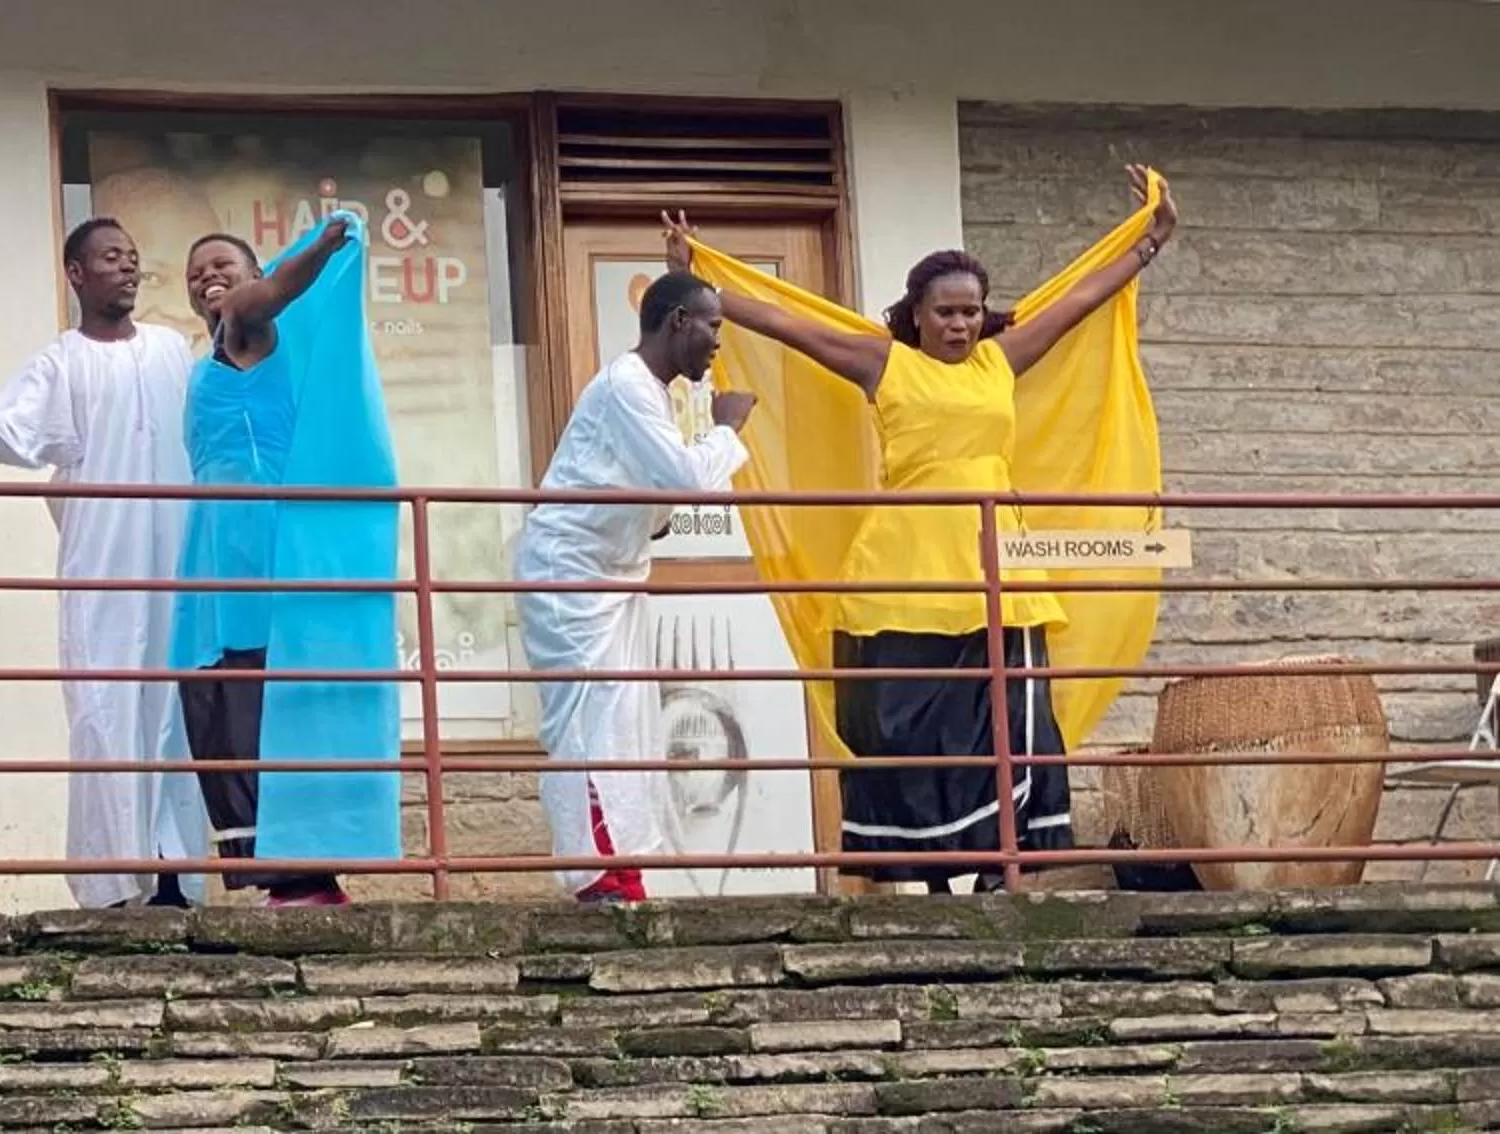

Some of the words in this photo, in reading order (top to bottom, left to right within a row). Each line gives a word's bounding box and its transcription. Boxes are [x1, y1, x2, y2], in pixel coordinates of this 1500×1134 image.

[381, 188, 429, 249] &
[384, 318, 423, 335] nails
[1005, 541, 1059, 557] WASH
[1064, 540, 1133, 557] ROOMS
